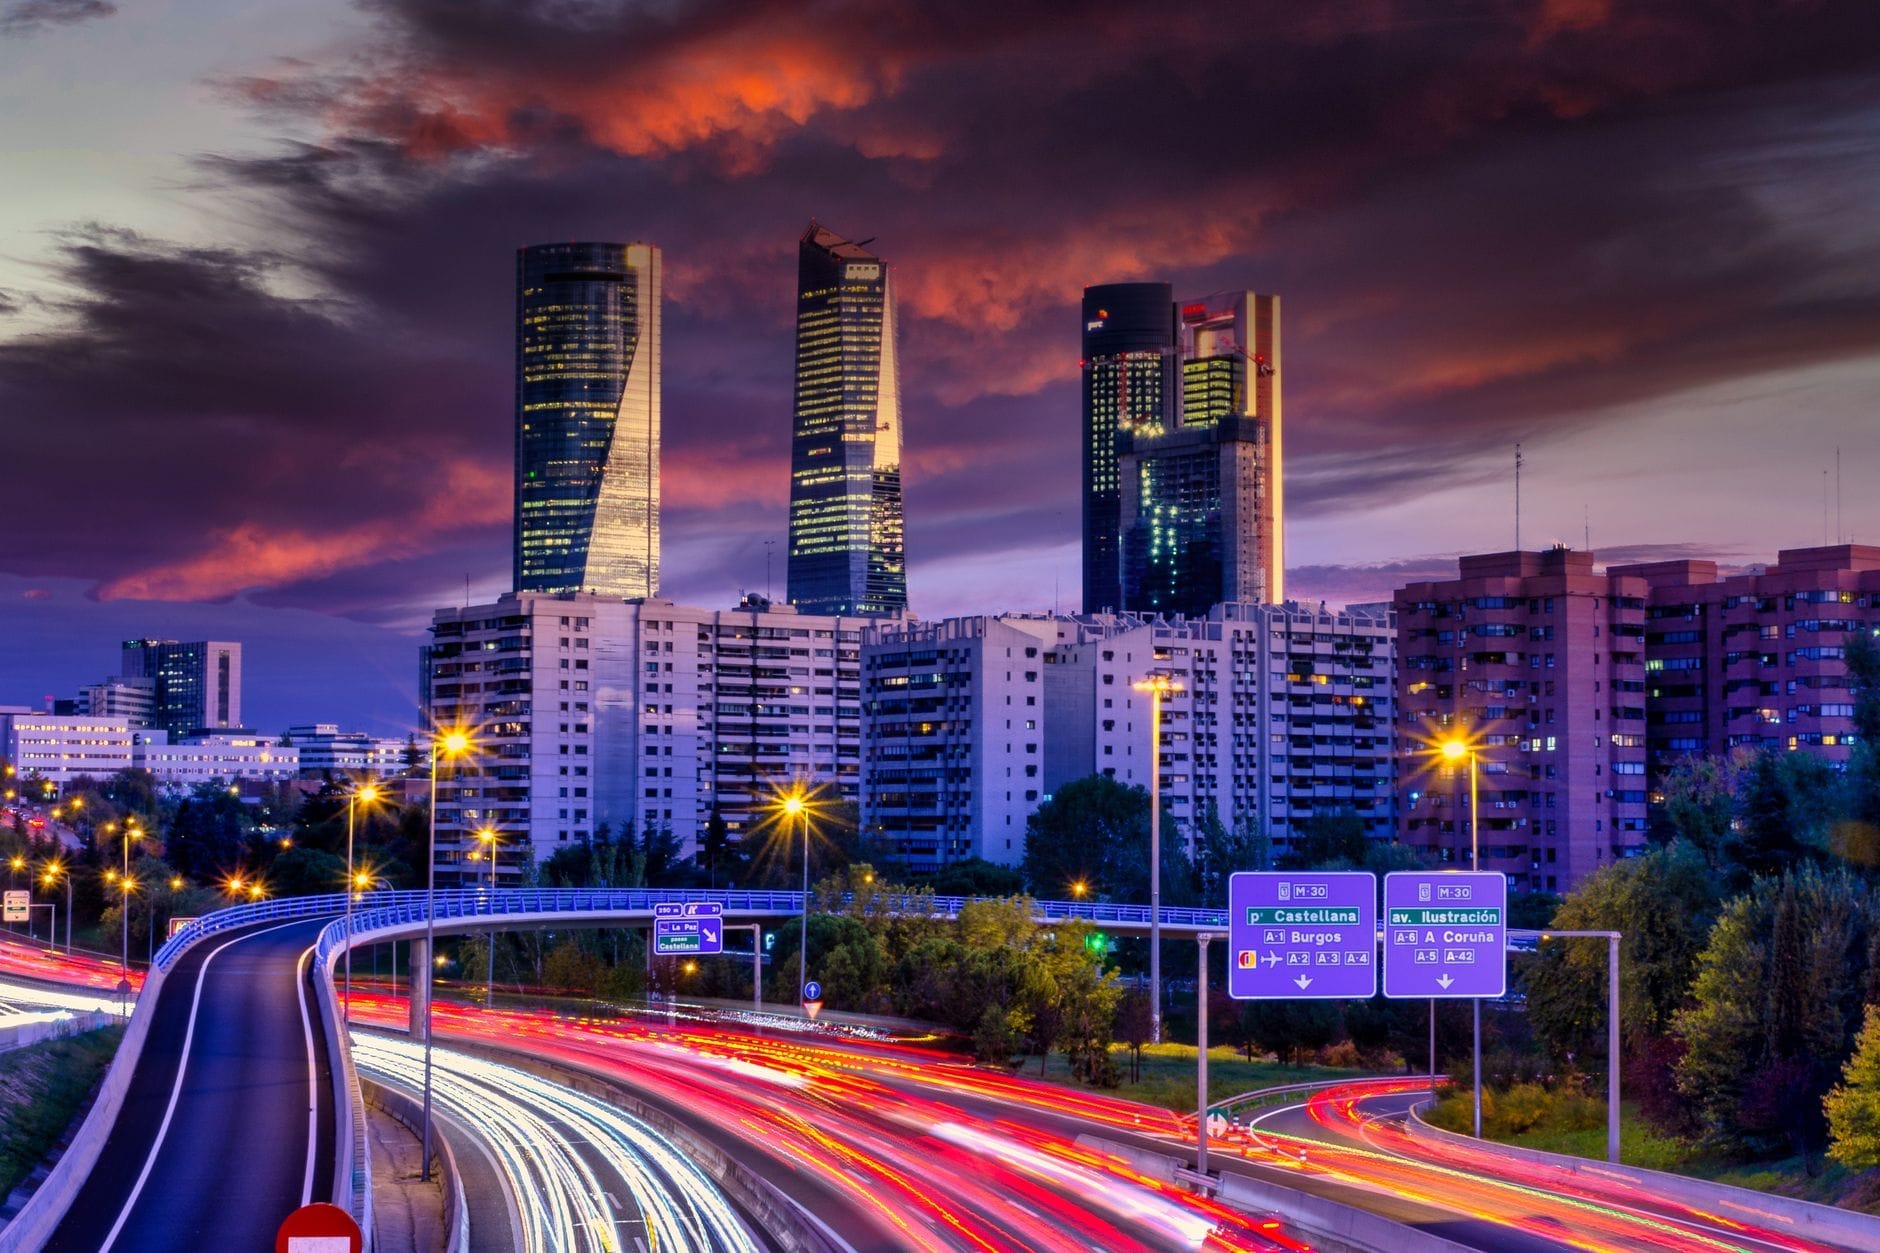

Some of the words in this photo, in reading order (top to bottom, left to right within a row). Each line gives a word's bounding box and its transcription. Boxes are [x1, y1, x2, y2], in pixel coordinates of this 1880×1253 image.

[1295, 886, 1326, 897] M-30
[1439, 887, 1470, 898] M-30
[1274, 909, 1357, 923] Castellana
[1392, 912, 1411, 923] av.
[1422, 910, 1497, 923] Ilustración
[1265, 931, 1284, 943] A-1
[1291, 931, 1342, 945] Burgos
[1396, 932, 1416, 943] A-6
[1424, 931, 1435, 943] A
[1443, 930, 1494, 943] Coruña
[1288, 953, 1309, 964] A-2
[1317, 953, 1338, 964] A-3
[1346, 953, 1368, 964] A-4
[1416, 951, 1437, 962] A-5
[1446, 951, 1473, 961] A-42
